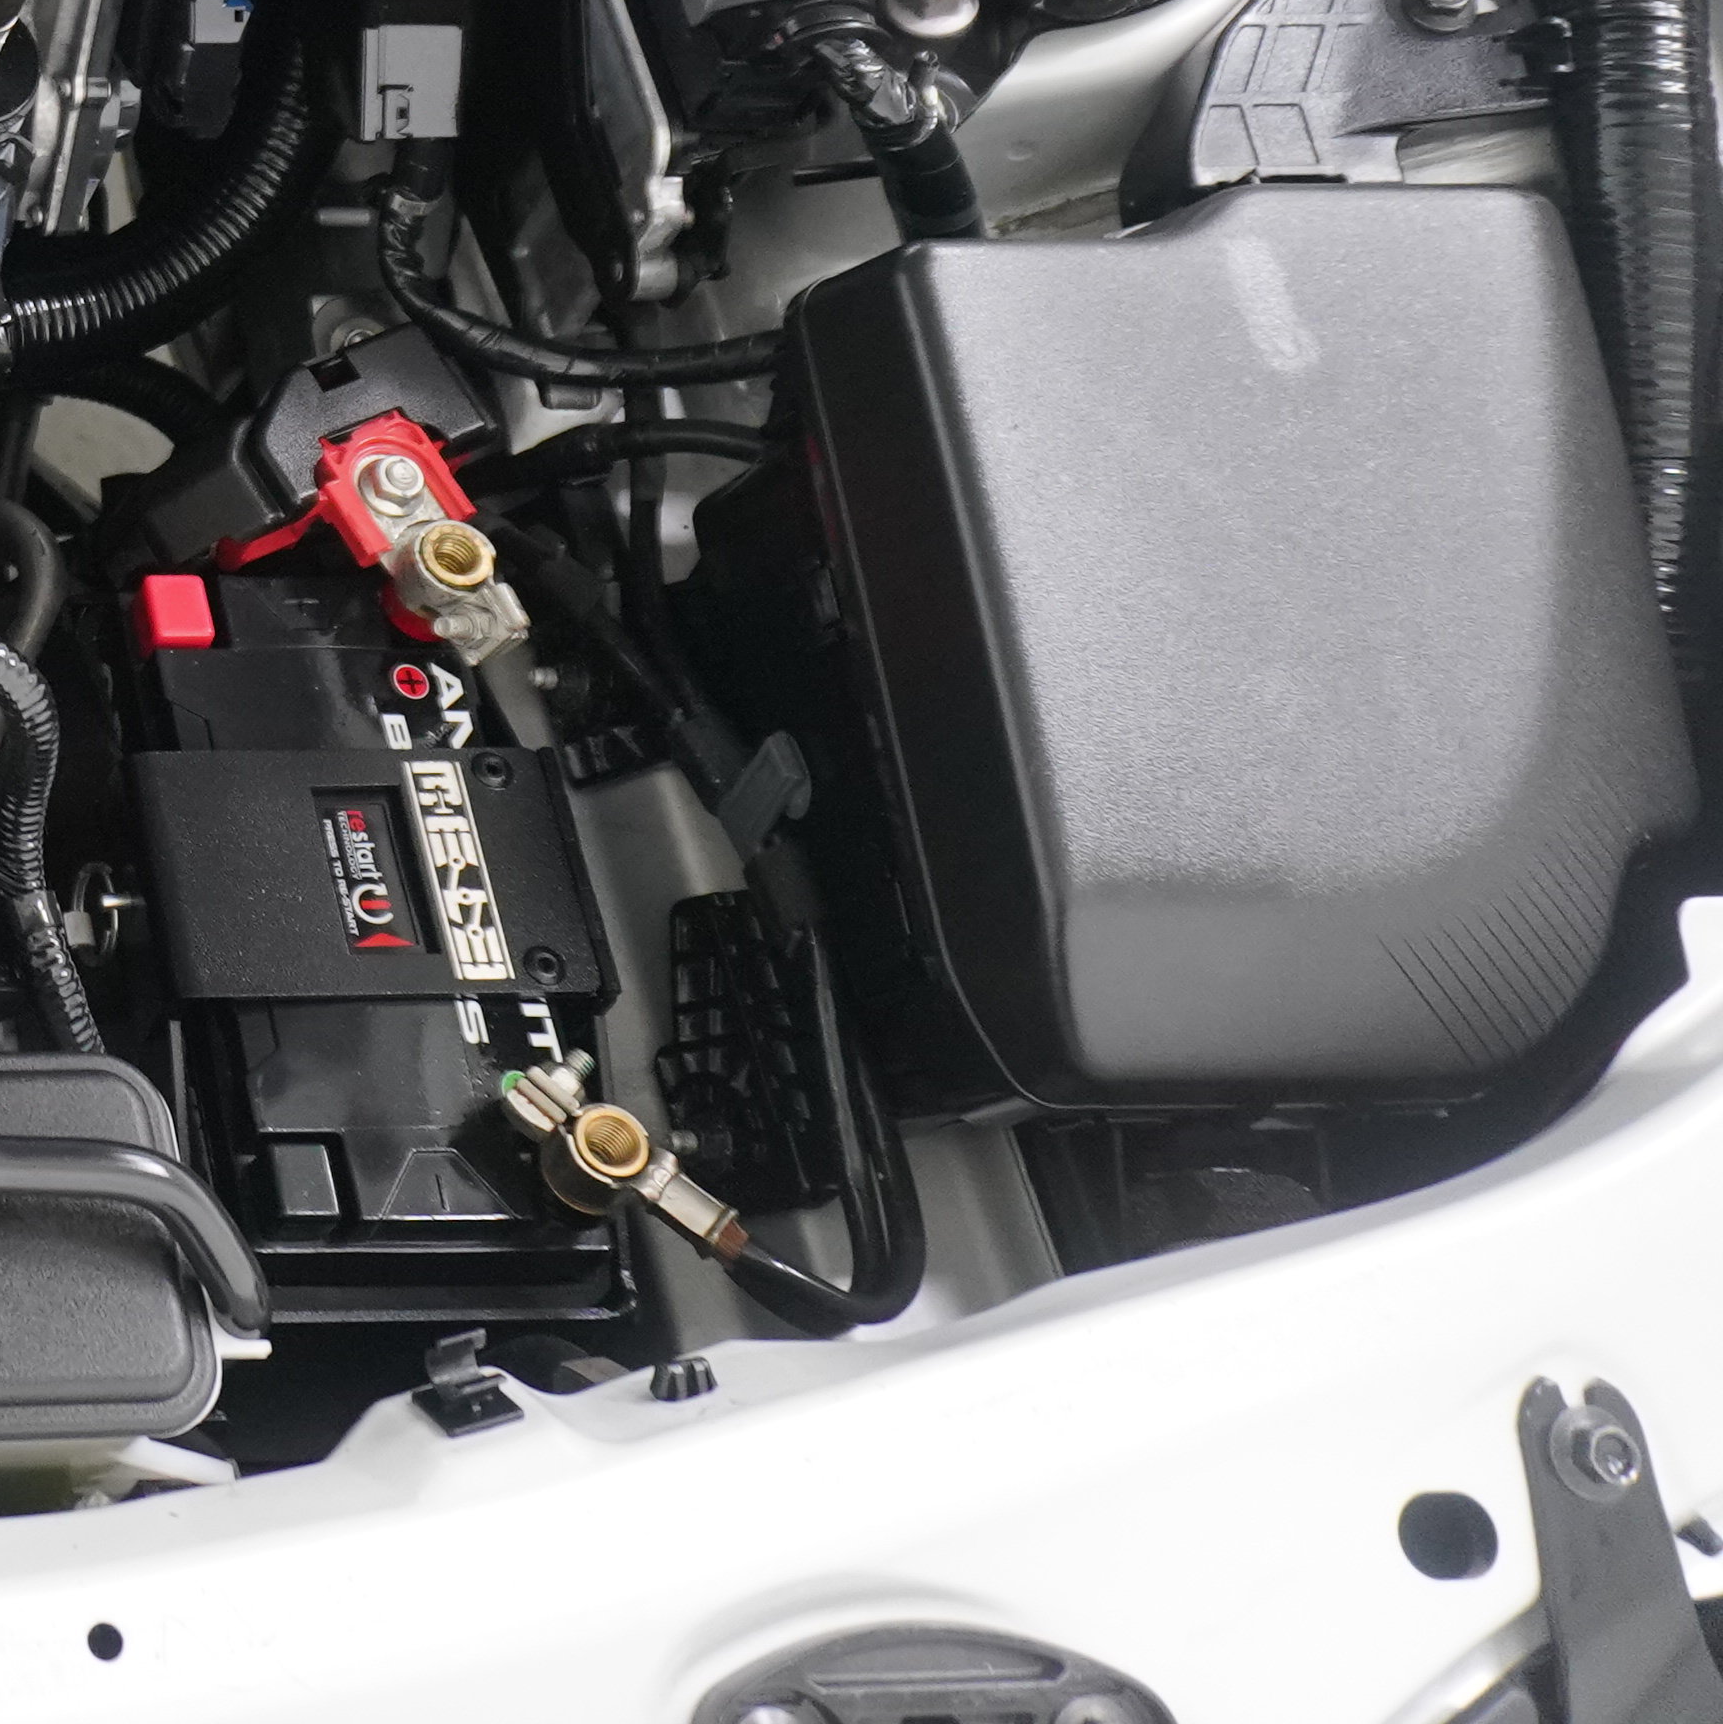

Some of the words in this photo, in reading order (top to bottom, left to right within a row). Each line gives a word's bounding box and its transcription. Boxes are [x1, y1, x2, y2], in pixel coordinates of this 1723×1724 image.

[322, 818, 340, 858] PRESS
[332, 859, 344, 878] TO
[336, 810, 363, 881] TECHNOLOGY
[346, 810, 383, 881] restart
